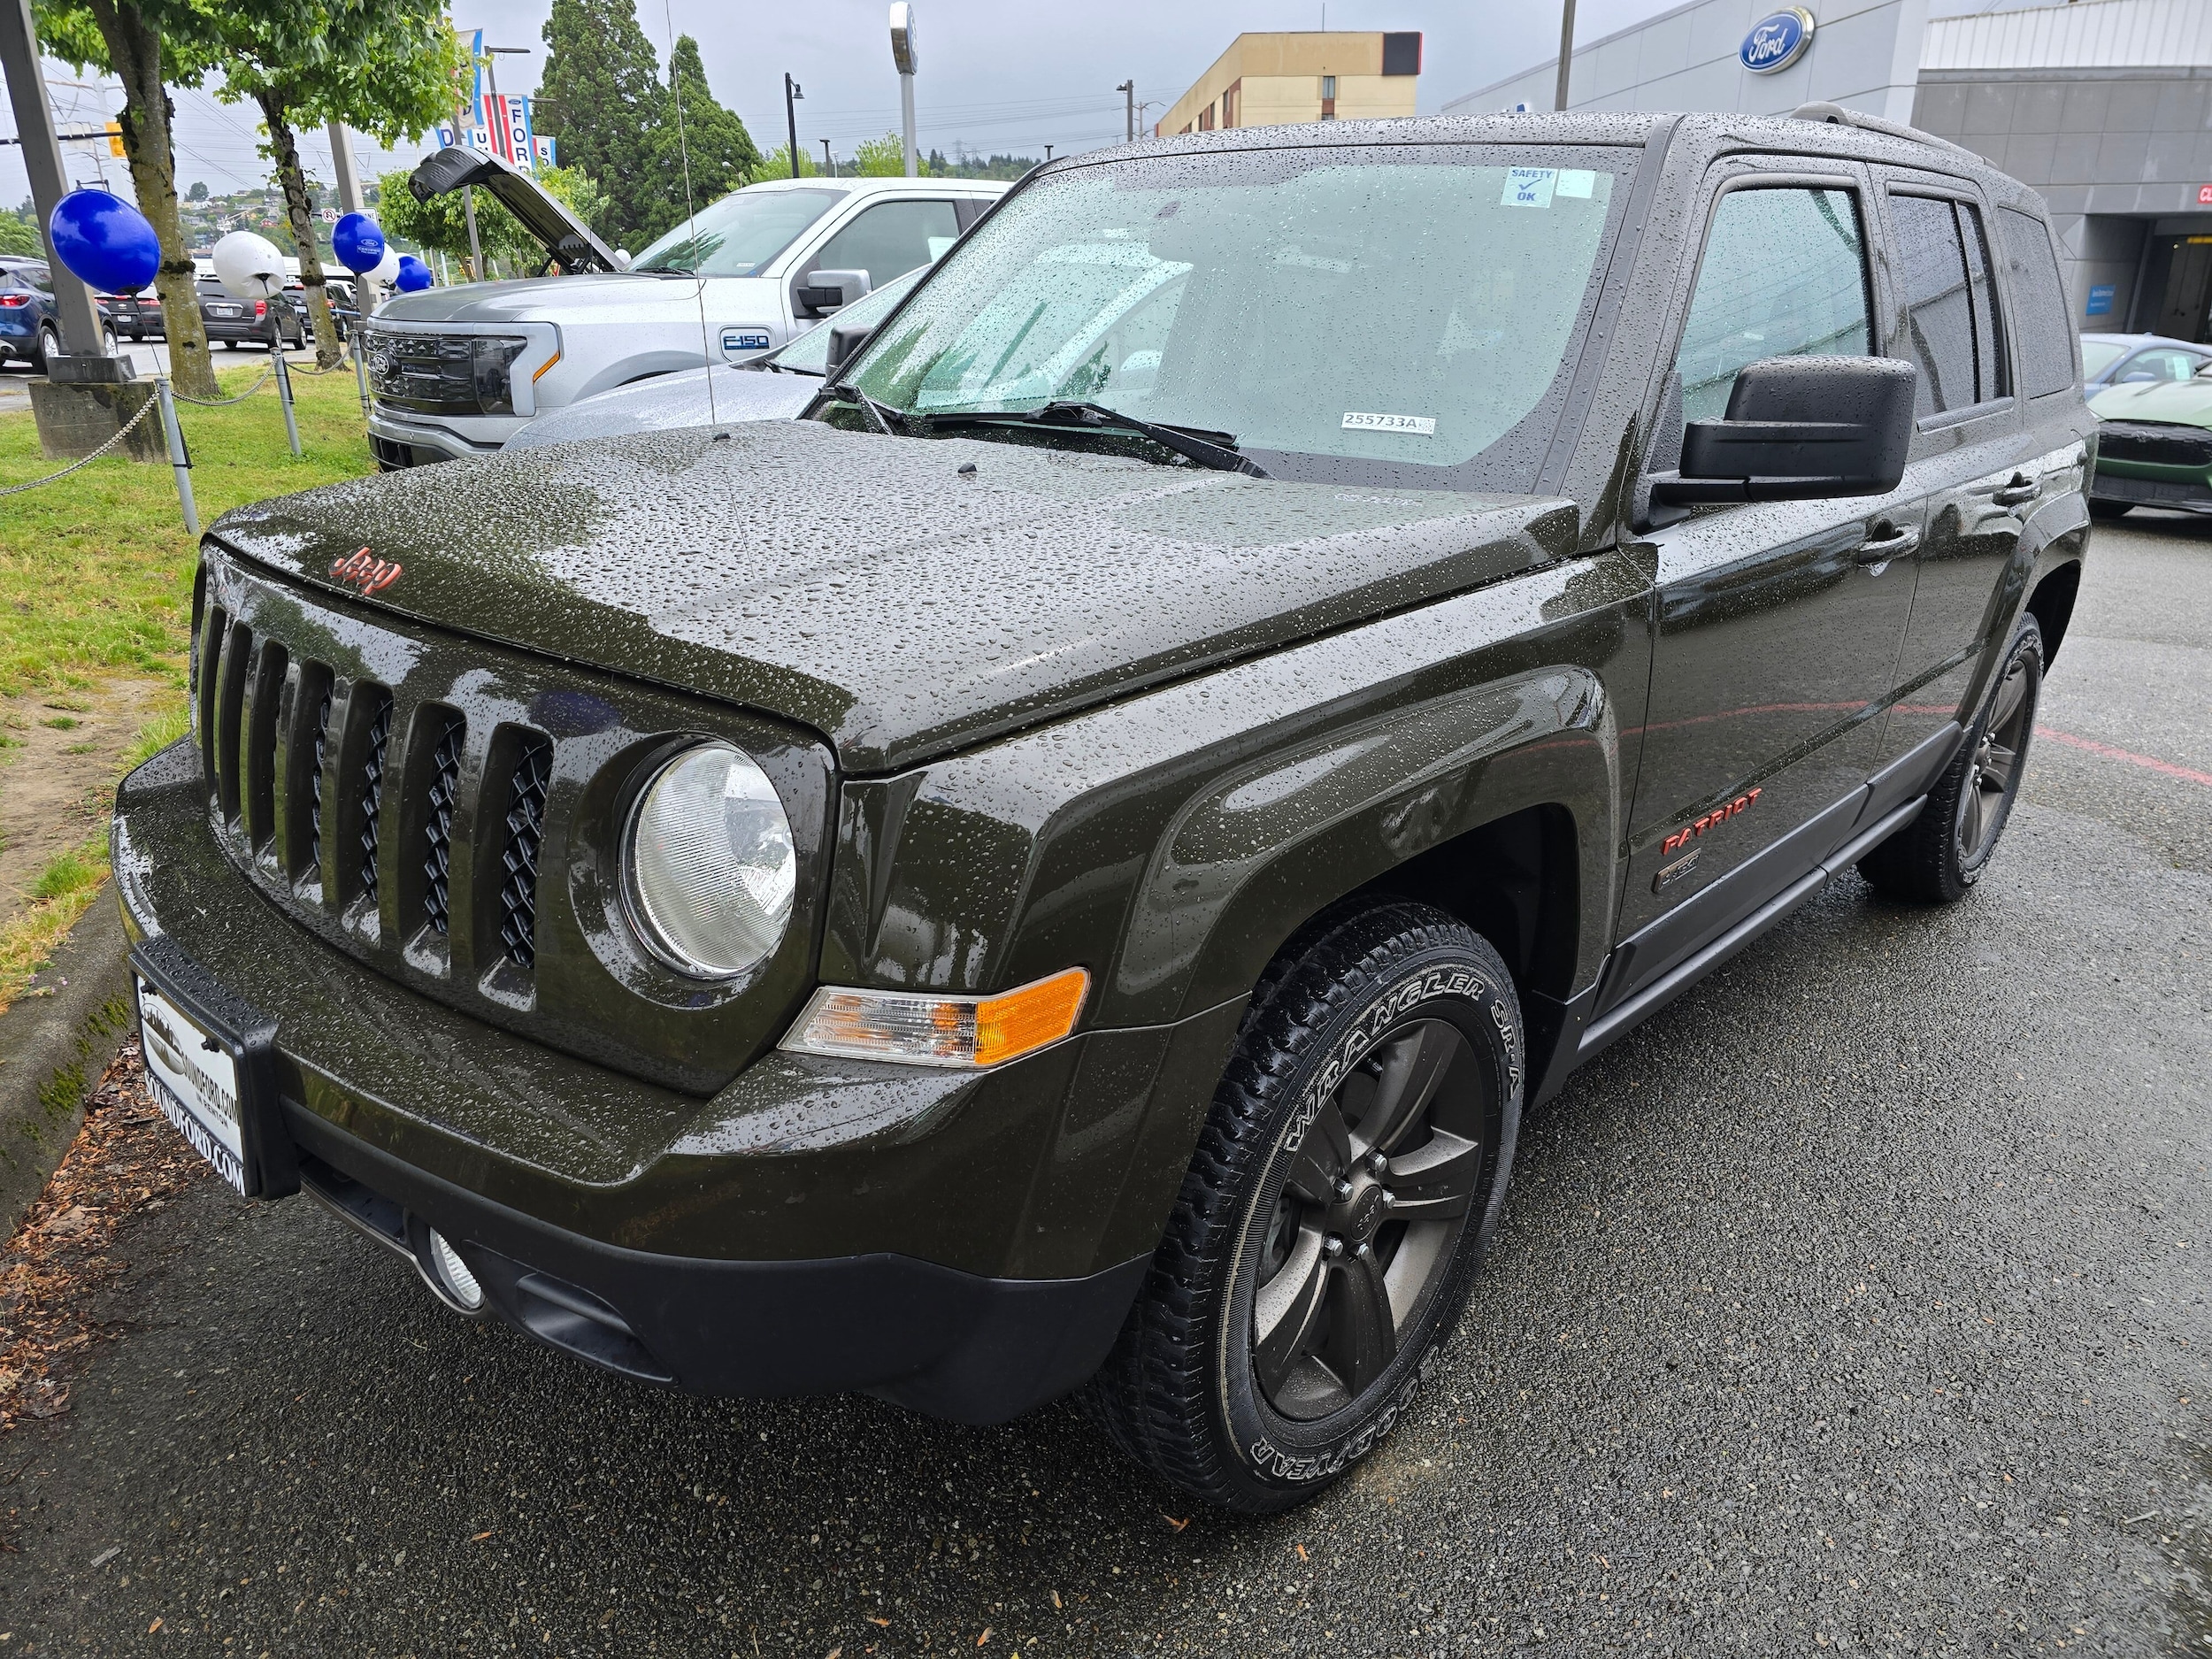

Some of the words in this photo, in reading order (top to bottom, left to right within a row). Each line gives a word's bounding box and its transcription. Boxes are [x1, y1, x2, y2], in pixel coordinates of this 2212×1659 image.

[1748, 24, 1788, 62] Ford
[1511, 169, 1553, 179] SAFETY
[1517, 192, 1536, 201] OK
[723, 335, 769, 347] F-150
[1345, 414, 1417, 428] 255733A
[328, 546, 403, 595] Jeep
[1661, 787, 1762, 856] PATRIOT
[1284, 972, 1485, 1151] WRANGLER
[144, 1069, 245, 1196] SOUNDFORD.COM
